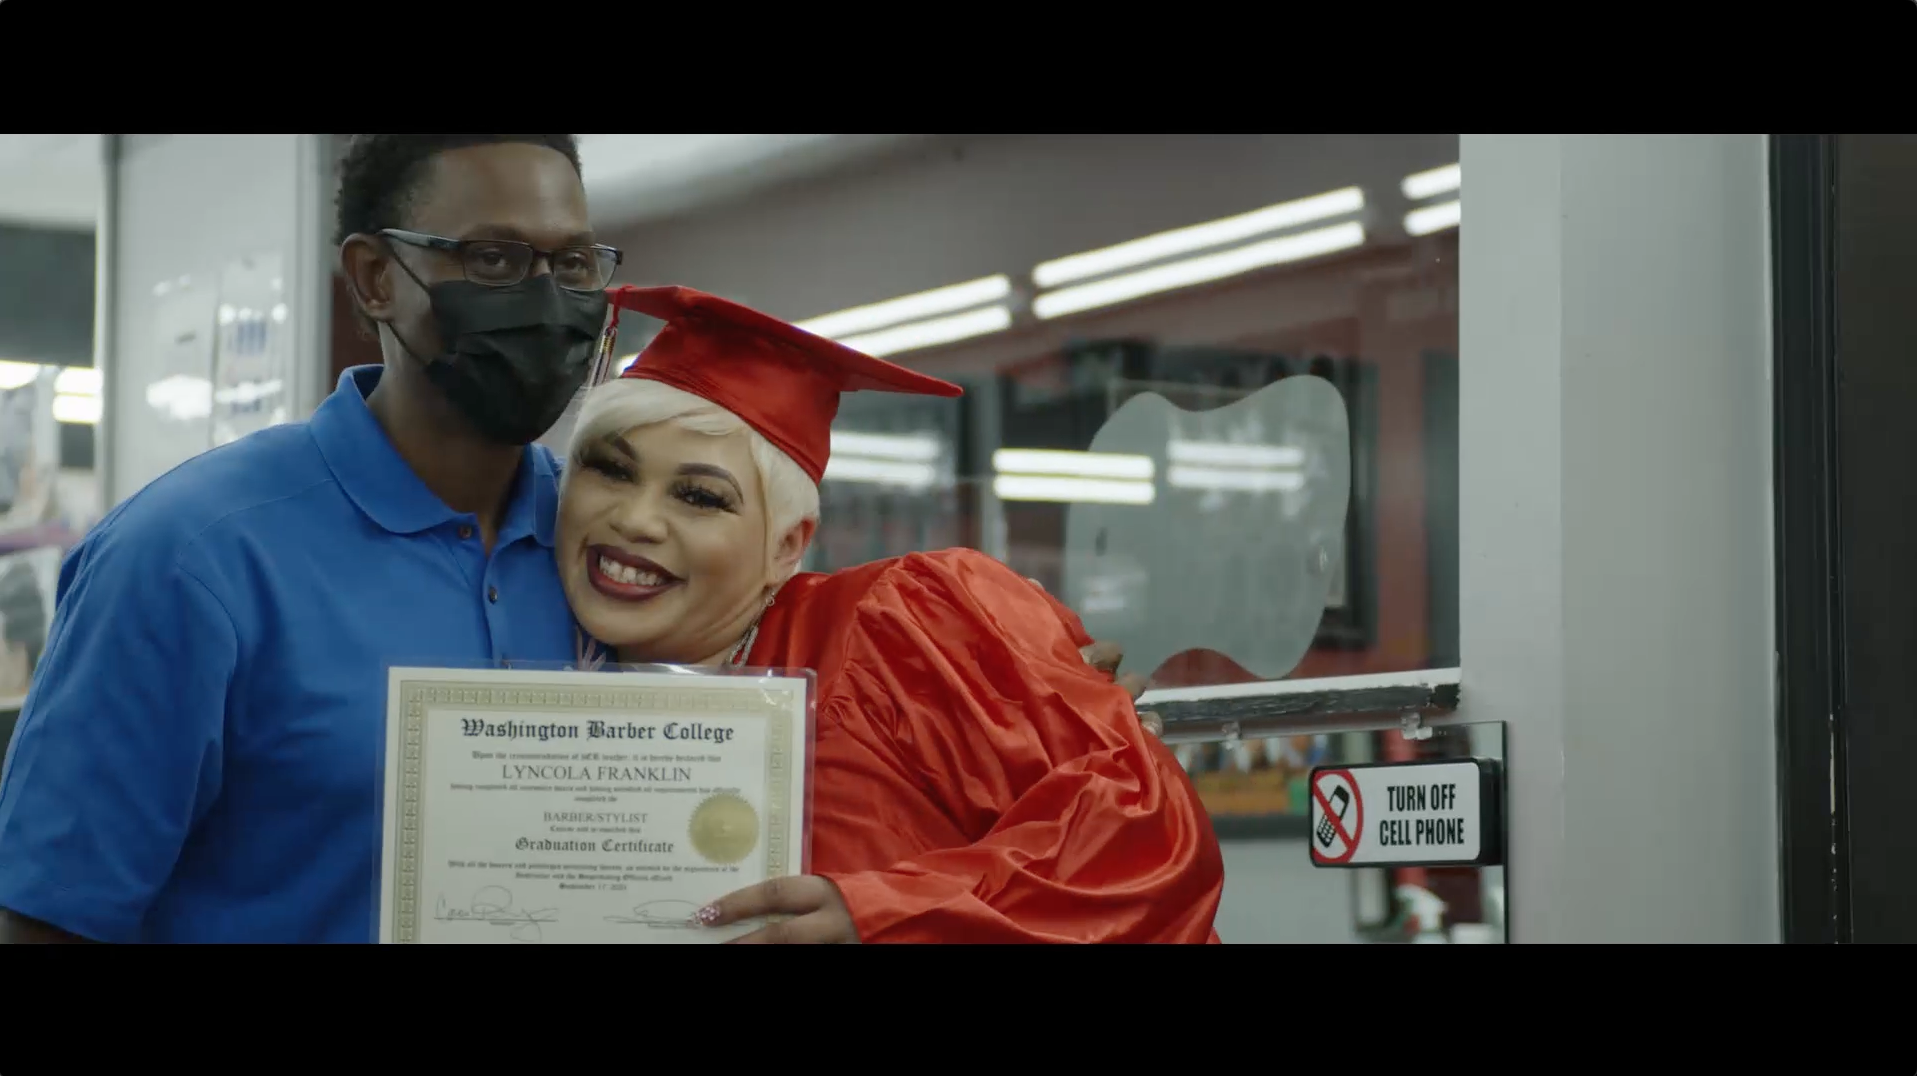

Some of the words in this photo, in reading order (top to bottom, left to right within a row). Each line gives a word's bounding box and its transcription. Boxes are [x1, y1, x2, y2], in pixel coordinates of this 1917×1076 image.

[461, 718, 579, 741] Washington
[586, 720, 656, 740] Barber
[663, 722, 734, 743] College
[502, 764, 591, 780] LYNCOLA
[597, 766, 692, 781] FRANKLIN
[1387, 785, 1426, 811] TURN
[1430, 784, 1456, 810] OFF
[1379, 820, 1411, 846] CELL
[1416, 818, 1464, 845] PHONE
[515, 837, 596, 852] Graduation
[601, 839, 674, 853] Certificate
